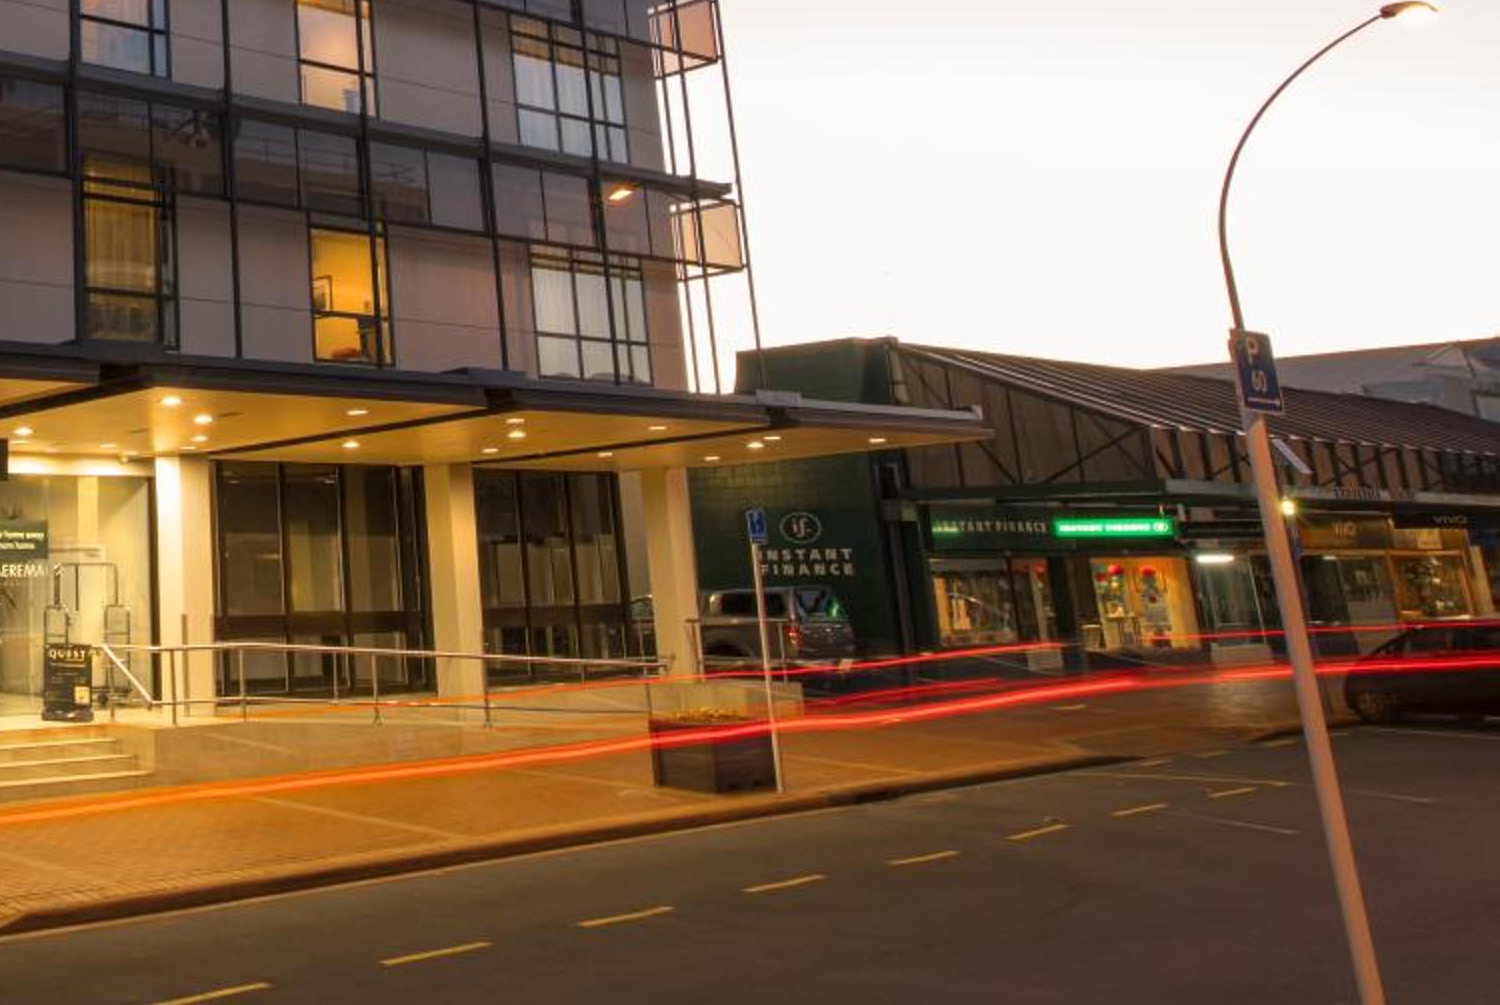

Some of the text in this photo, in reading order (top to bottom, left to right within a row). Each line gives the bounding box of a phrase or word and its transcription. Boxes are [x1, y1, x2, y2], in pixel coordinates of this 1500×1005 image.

[1245, 336, 1260, 365] P
[759, 548, 855, 576] INSTANT FINANCE
